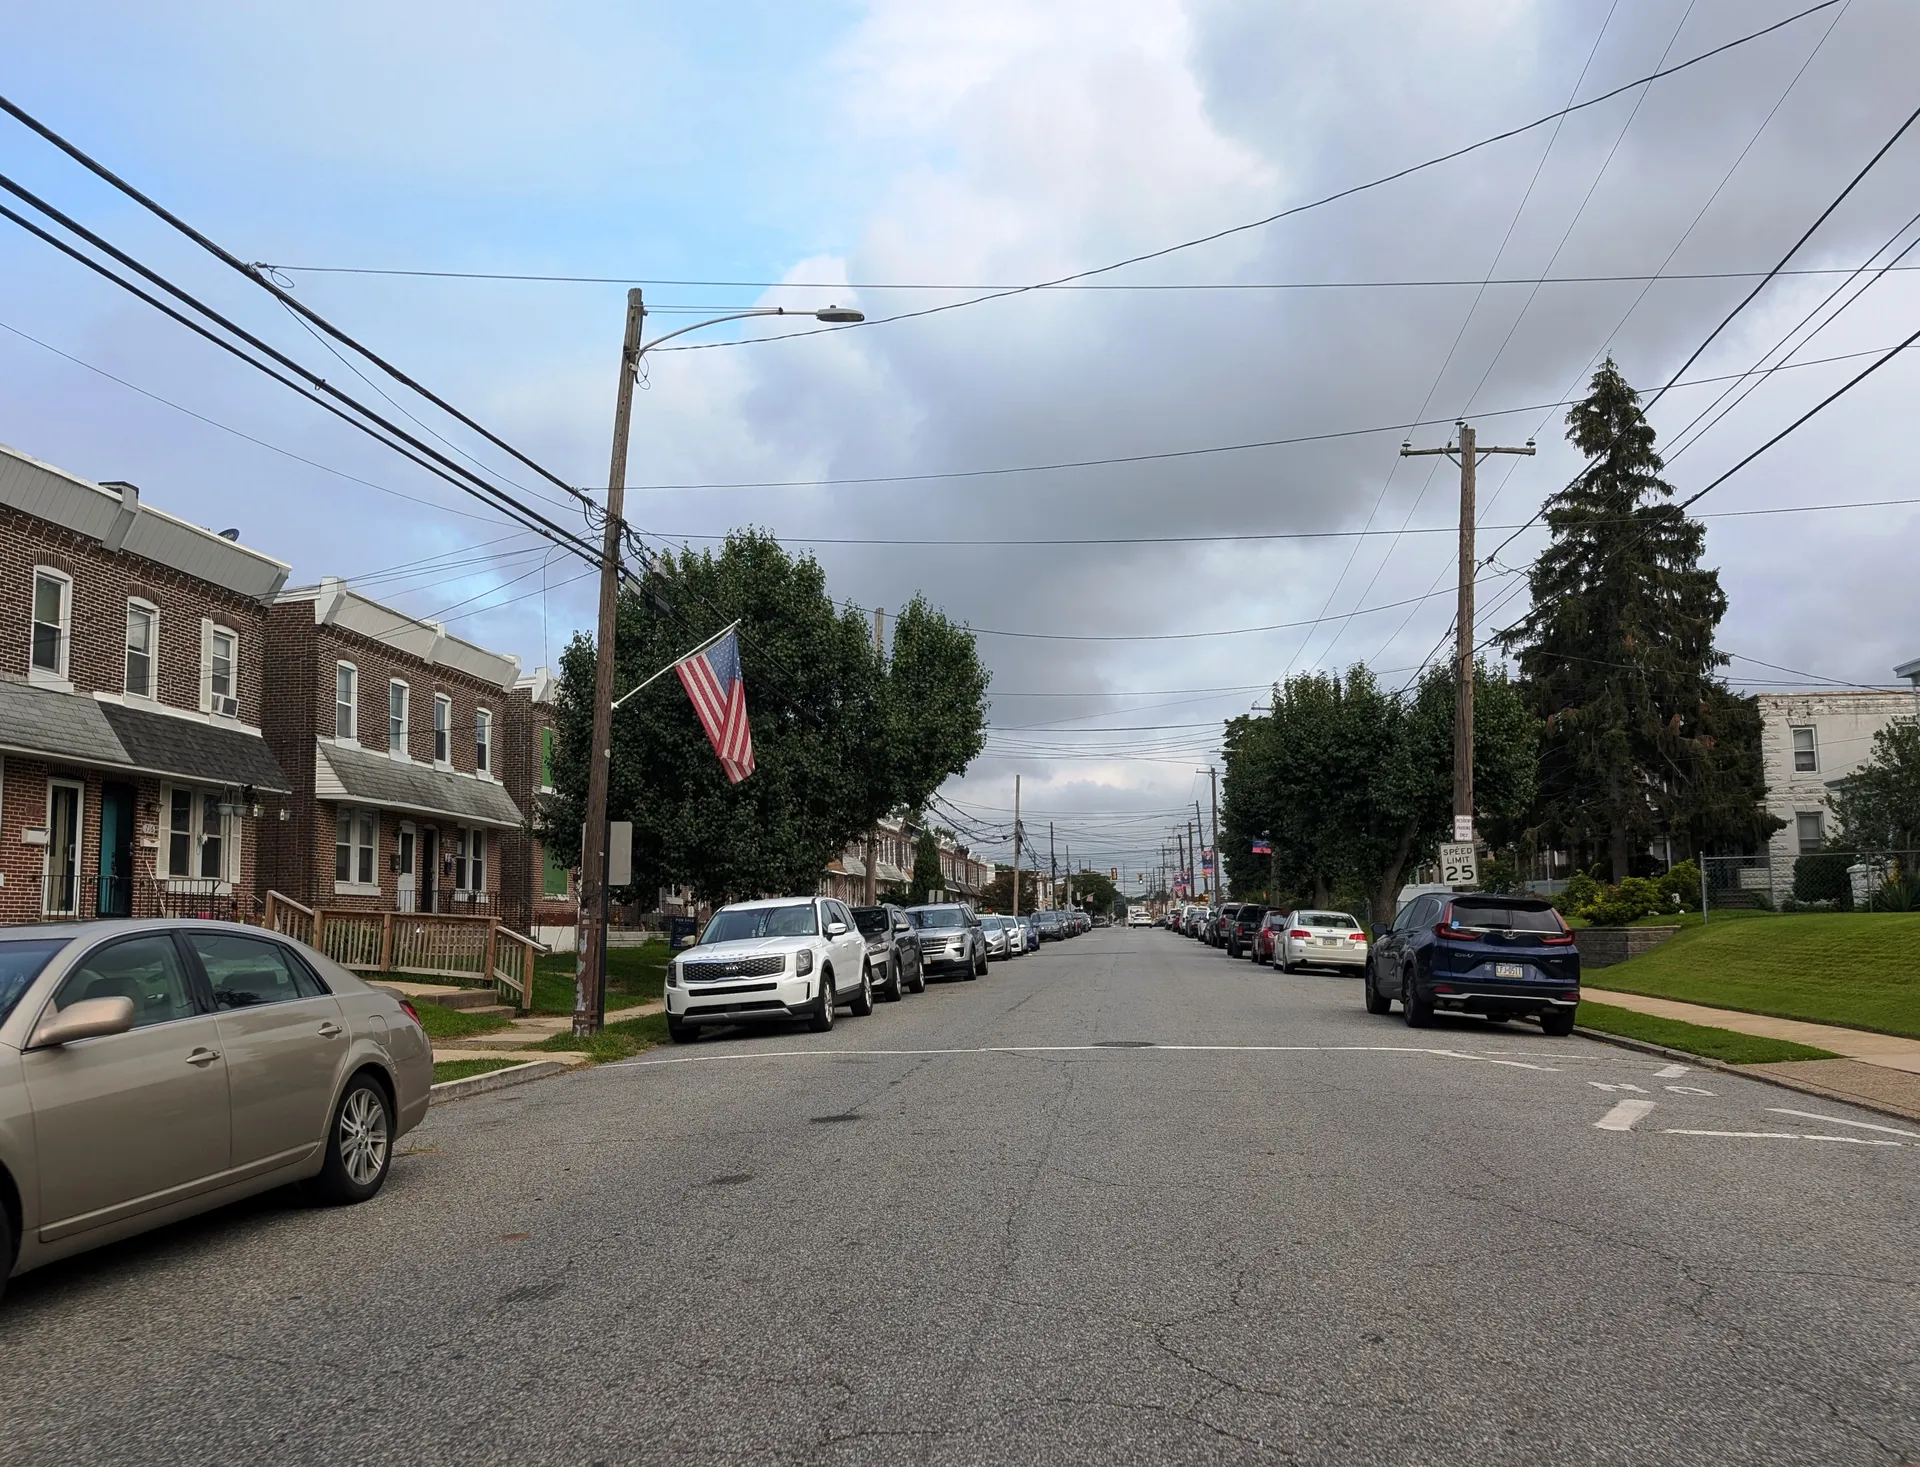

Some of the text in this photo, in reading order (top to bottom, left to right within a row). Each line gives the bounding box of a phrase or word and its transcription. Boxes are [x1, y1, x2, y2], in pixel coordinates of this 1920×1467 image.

[1443, 847, 1473, 856] SPEED
[1446, 856, 1470, 864] LIMIT
[1445, 865, 1474, 882] 25
